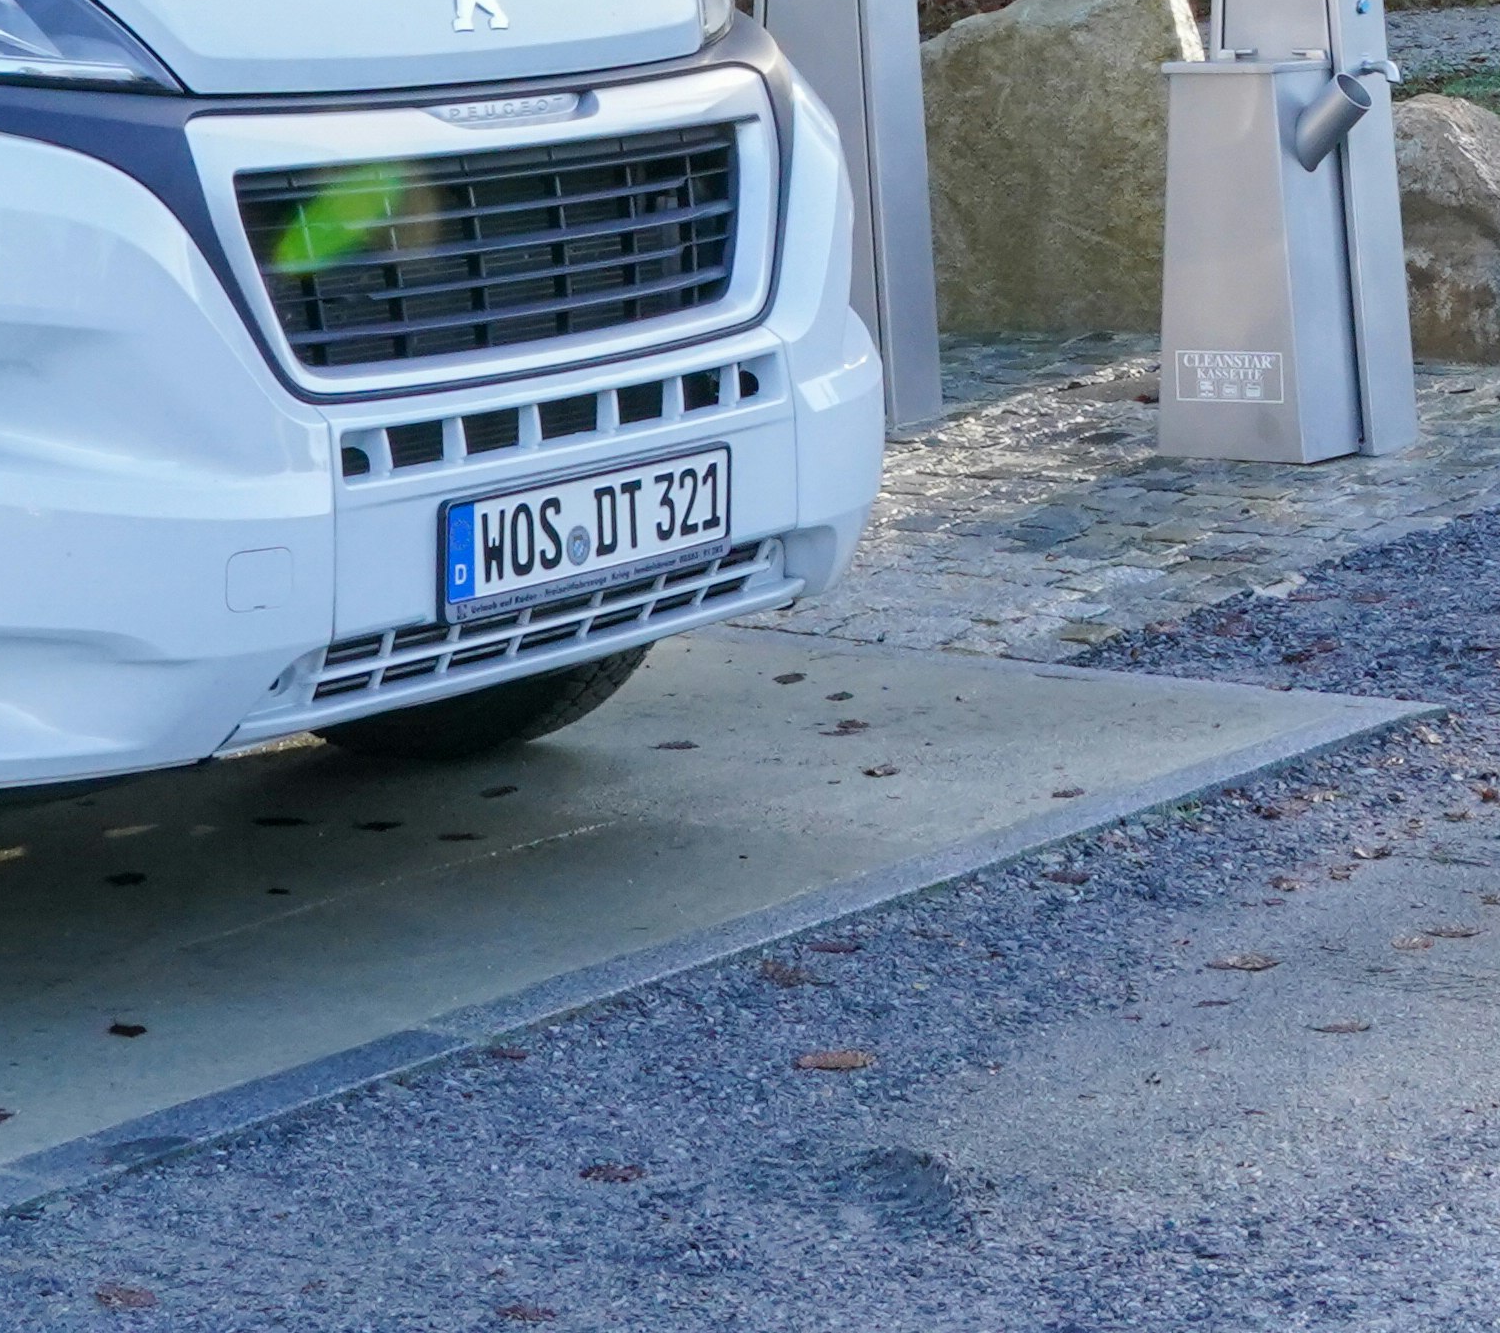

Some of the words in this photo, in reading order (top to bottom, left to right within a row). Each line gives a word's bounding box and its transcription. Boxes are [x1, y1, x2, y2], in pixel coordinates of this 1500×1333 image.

[1183, 353, 1274, 369] CLEANSTAR
[1196, 368, 1263, 381] KASSETTE
[481, 496, 563, 584] WOS
[593, 478, 643, 558] DT
[653, 461, 722, 542] 321
[454, 564, 467, 585] D
